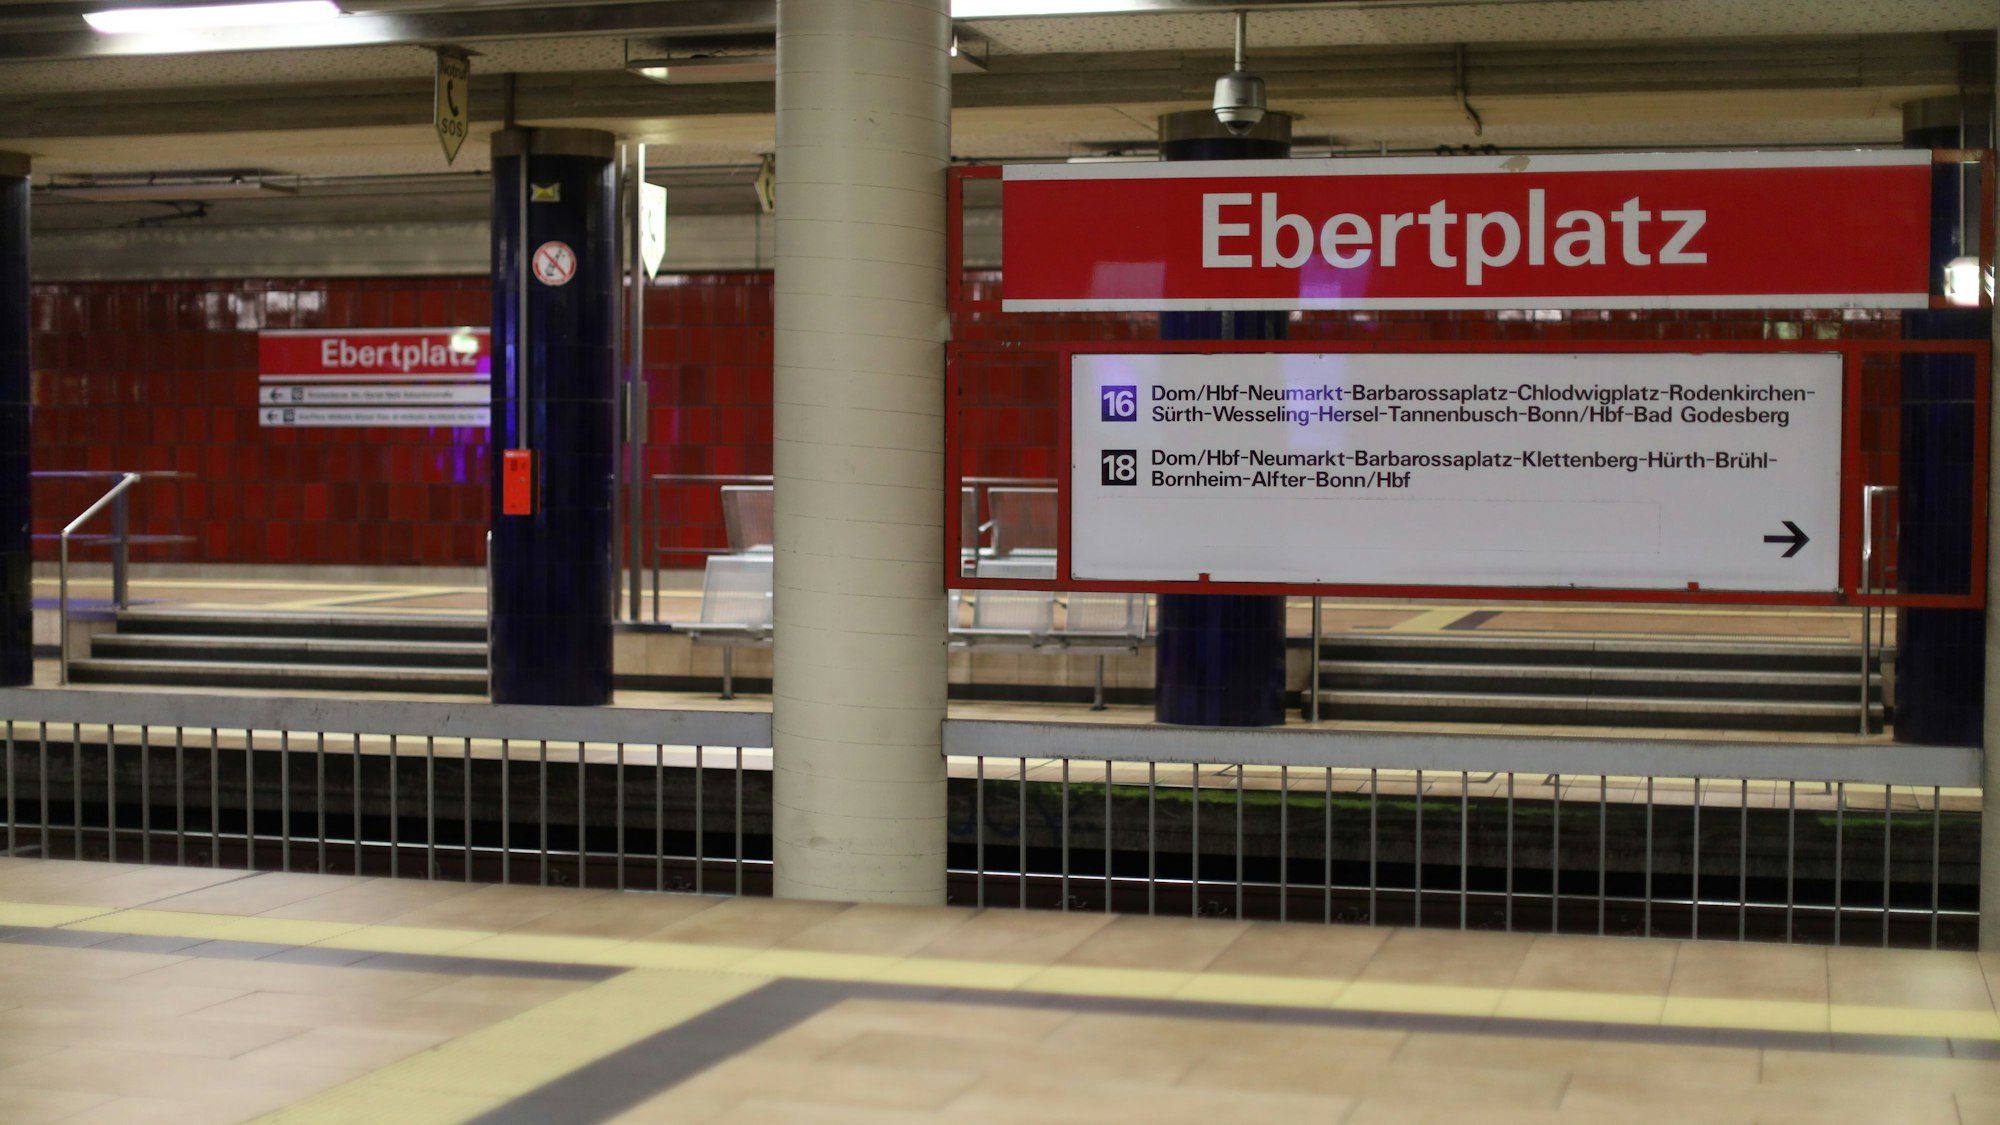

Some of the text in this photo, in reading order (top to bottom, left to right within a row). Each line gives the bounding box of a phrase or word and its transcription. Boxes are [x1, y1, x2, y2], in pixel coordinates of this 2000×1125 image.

[441, 117, 463, 136] SOS
[1201, 188, 1708, 286] Ebertplatz
[320, 338, 477, 373] Ebertplatz
[1103, 389, 1136, 418] 16
[1151, 384, 1816, 406] Dom/Hbf-Neumarkt-Barbarossaplatz-Chlodwigplatz-Rodenkirchen-
[1151, 404, 1790, 427] Sürth-Wesseling-Hersel-Tannenbusch-Bonn/Hbf-Bad Godesberg
[1103, 454, 1136, 482] 18
[1151, 449, 1778, 473] Dom/Hbf-Neumarkt-Barbarossaplatz-Klettenberg-Hürth-Brühl-
[1151, 470, 1412, 488] Bornheim-Alfter-Bonn/Hbf
